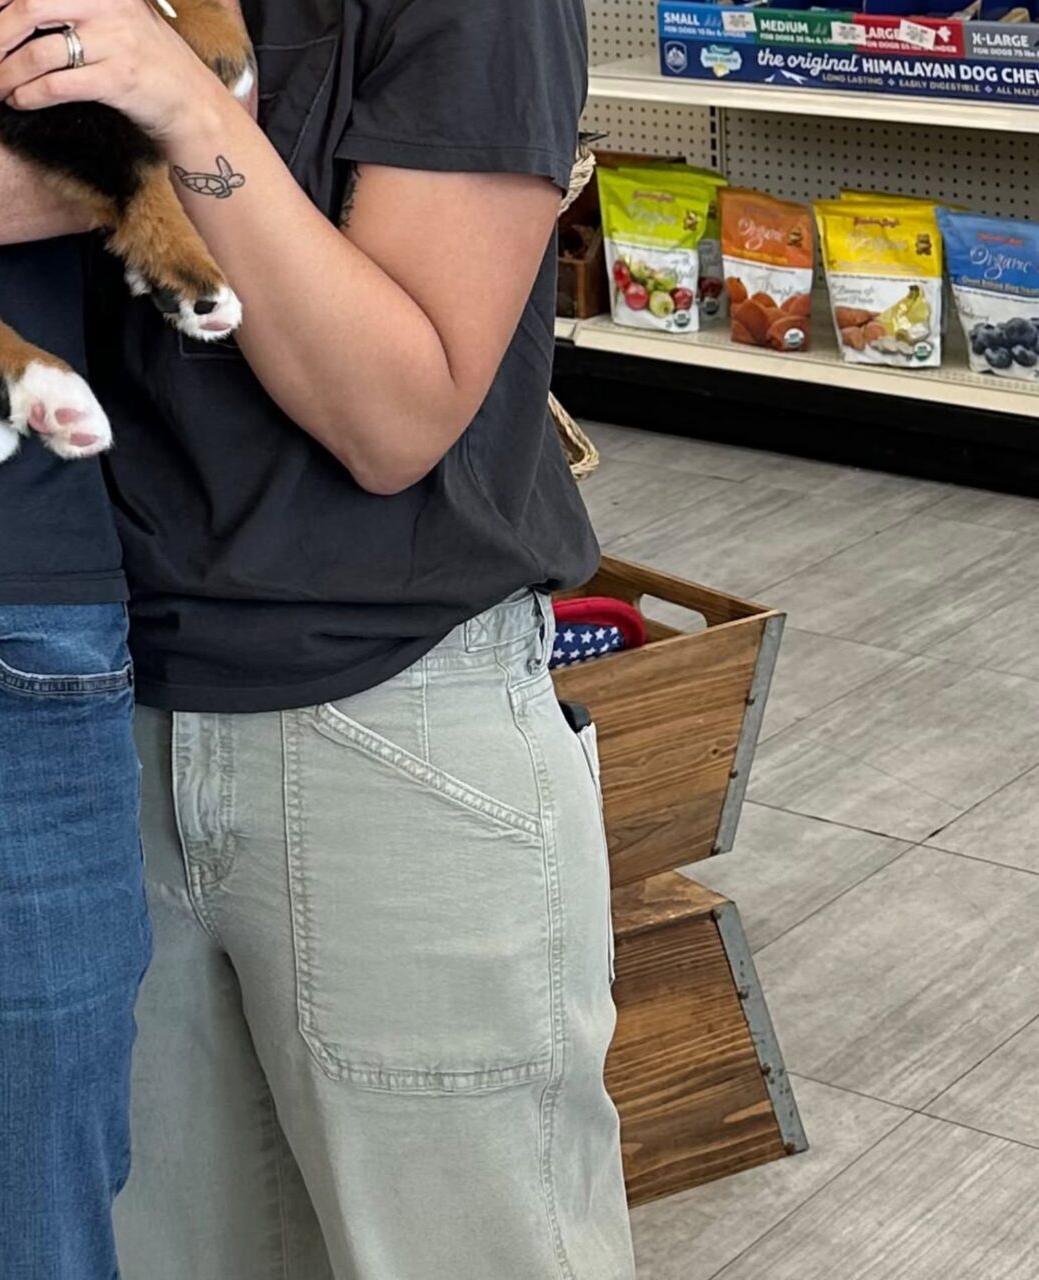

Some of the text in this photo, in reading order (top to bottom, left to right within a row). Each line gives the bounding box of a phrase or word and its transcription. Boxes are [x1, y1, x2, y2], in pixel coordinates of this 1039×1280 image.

[664, 12, 700, 26] SMALL
[761, 19, 808, 34] MEDIUM
[972, 32, 1029, 48] X-LARGE
[973, 47, 989, 55] FOR
[990, 48, 1011, 57] DOGS
[757, 48, 785, 68] the
[787, 51, 860, 76] original
[862, 59, 956, 79] HIMALAYAN
[961, 65, 997, 82] DOG
[822, 73, 847, 82] LONG
[847, 77, 883, 86] LASTING
[899, 79, 927, 89] EASILY
[929, 81, 981, 93] DIGESTIBLE
[996, 86, 1012, 94] ALL
[970, 244, 1033, 281] Organic
